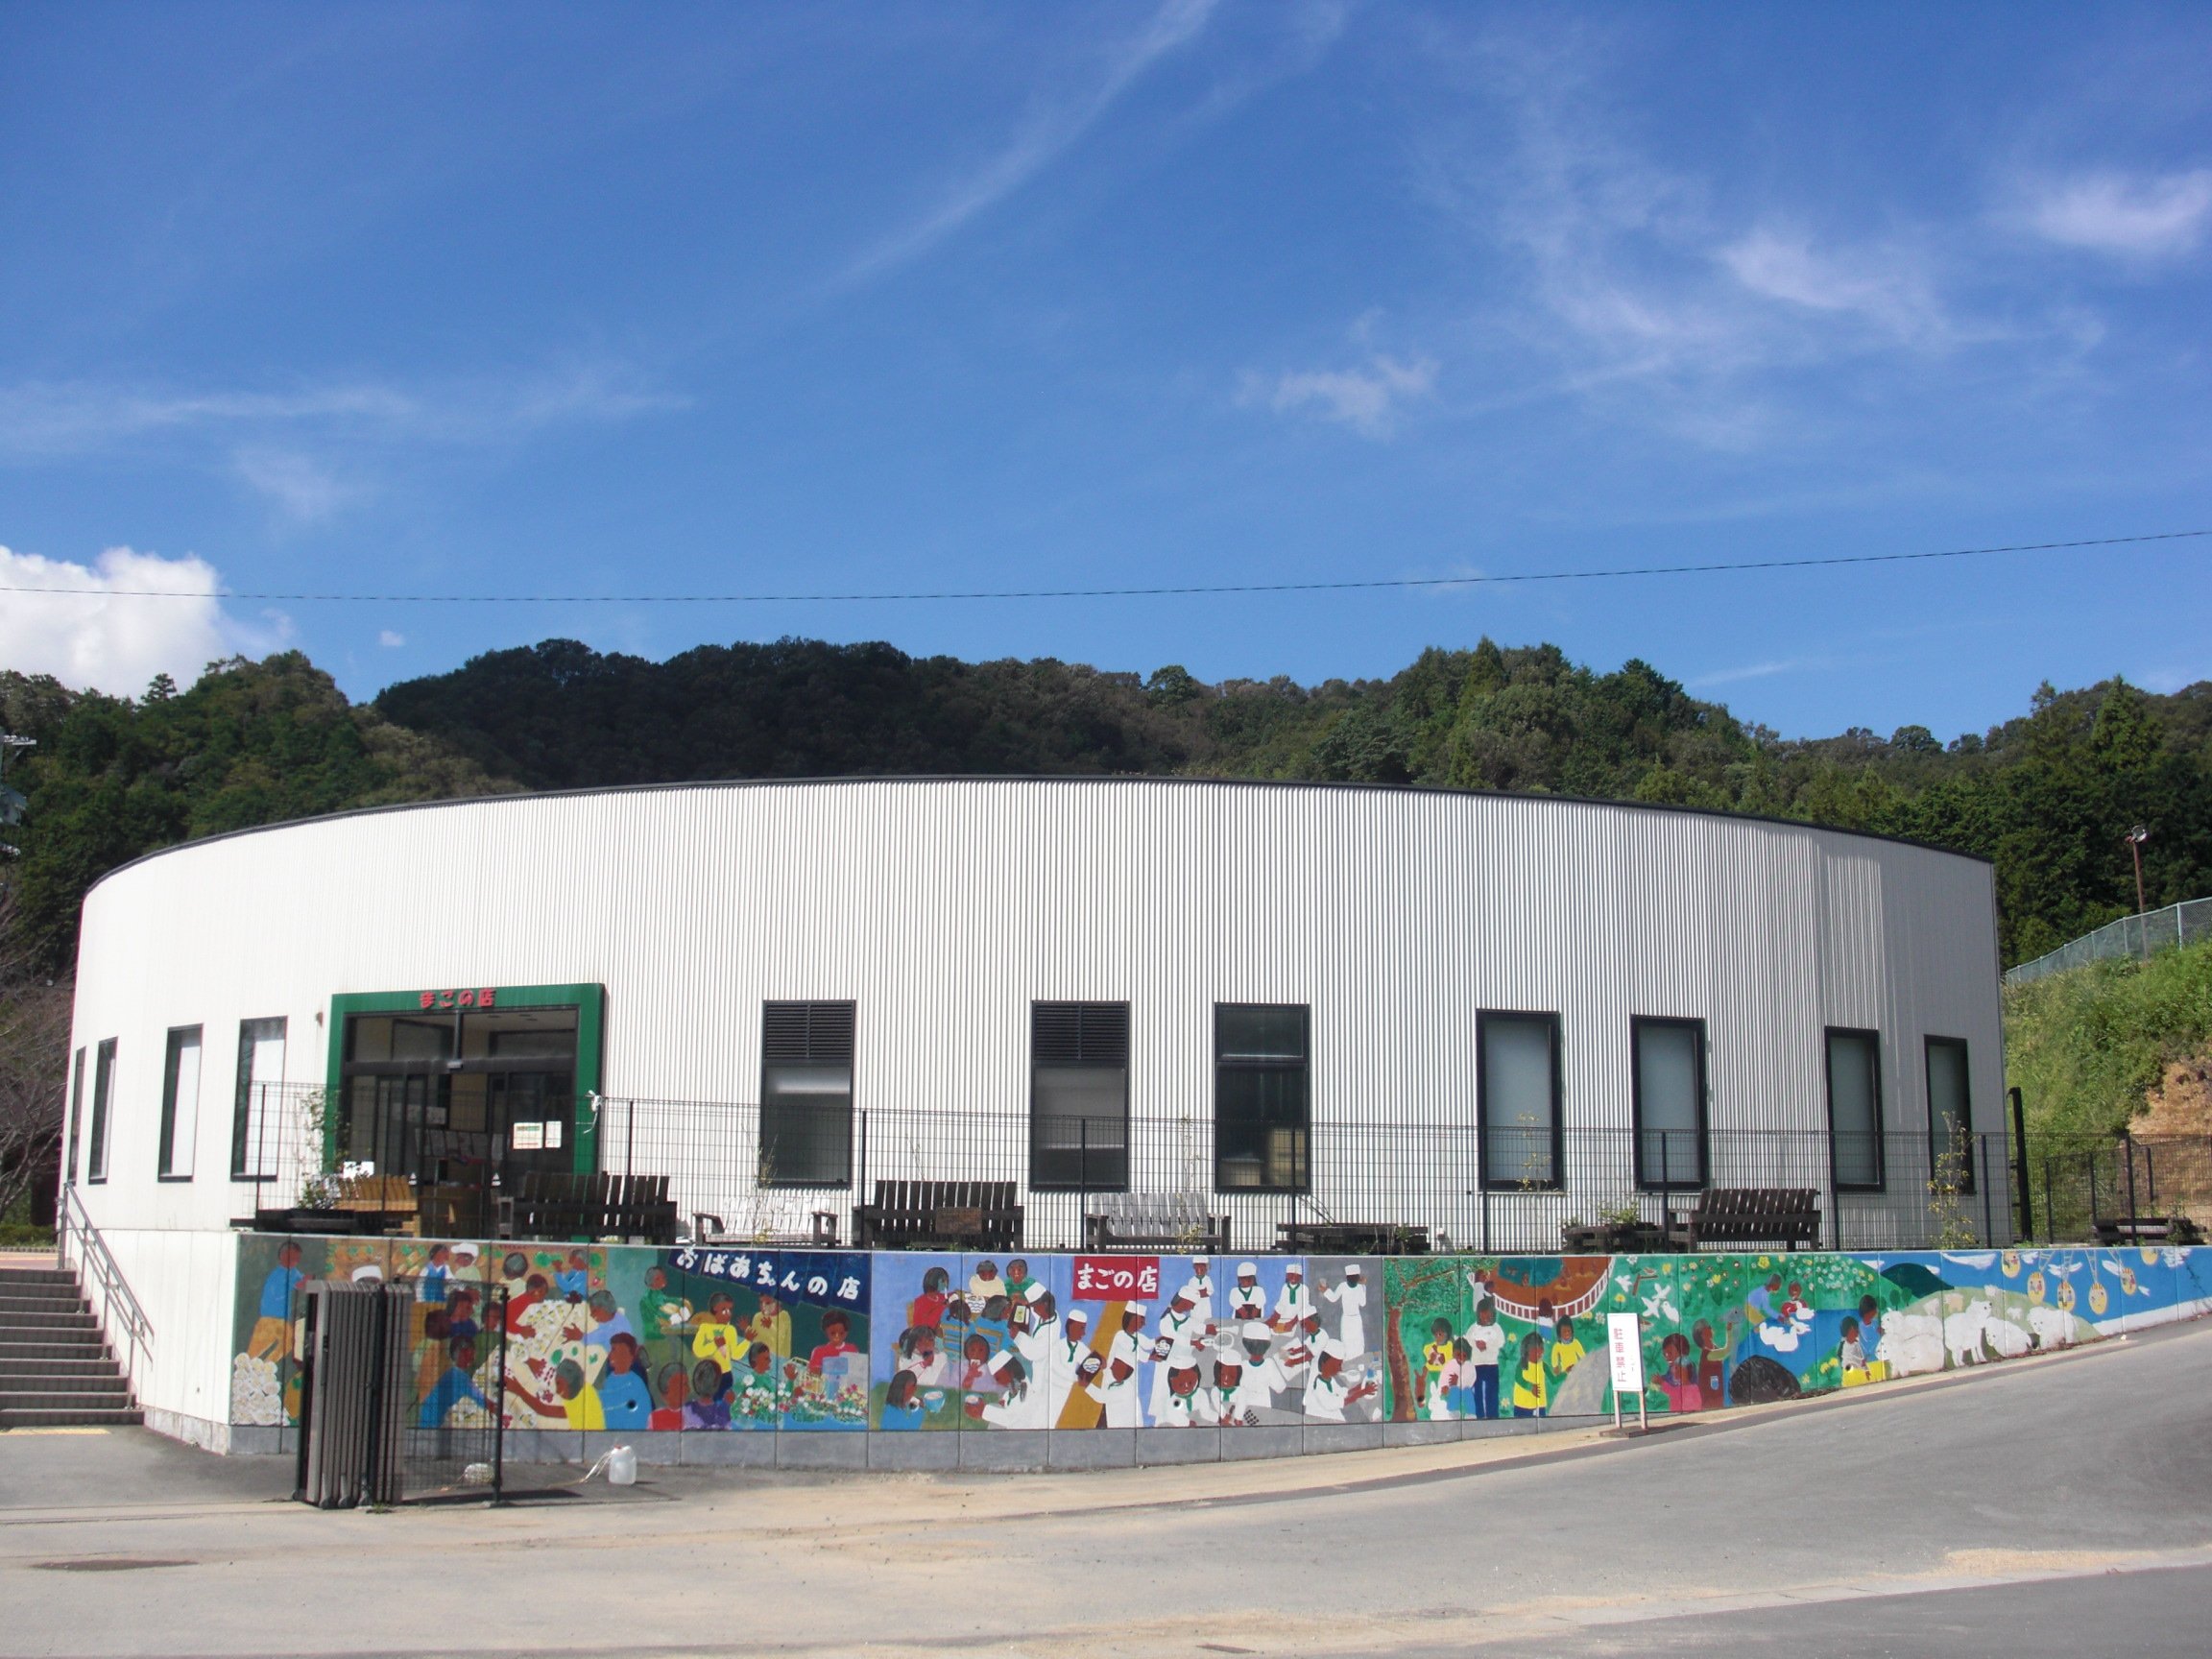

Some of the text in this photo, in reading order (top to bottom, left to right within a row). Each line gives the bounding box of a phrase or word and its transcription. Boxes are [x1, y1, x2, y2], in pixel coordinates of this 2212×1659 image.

[677, 1245, 860, 1300] おばあちゃんの店
[1077, 1262, 1158, 1292] まごの店
[1614, 1328, 1626, 1382] 駐車禁止
